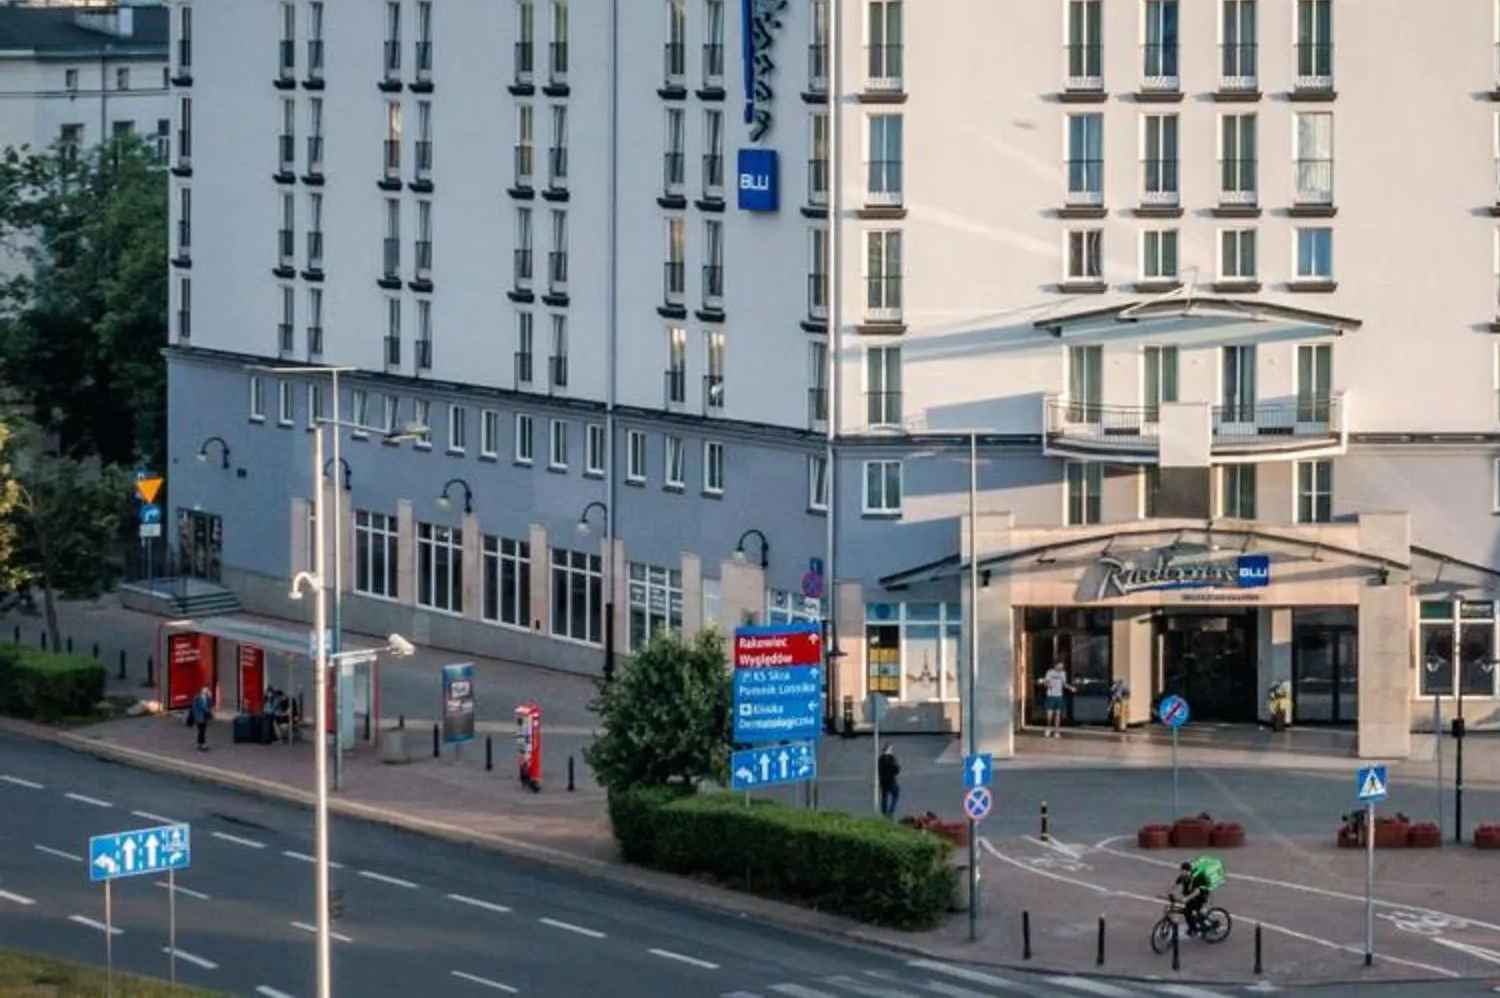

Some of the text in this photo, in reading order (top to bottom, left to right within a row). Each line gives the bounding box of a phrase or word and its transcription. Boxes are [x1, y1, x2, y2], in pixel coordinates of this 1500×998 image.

[739, 173, 769, 191] BLU
[1239, 568, 1267, 578] BLU
[739, 637, 788, 649] Rakowiec
